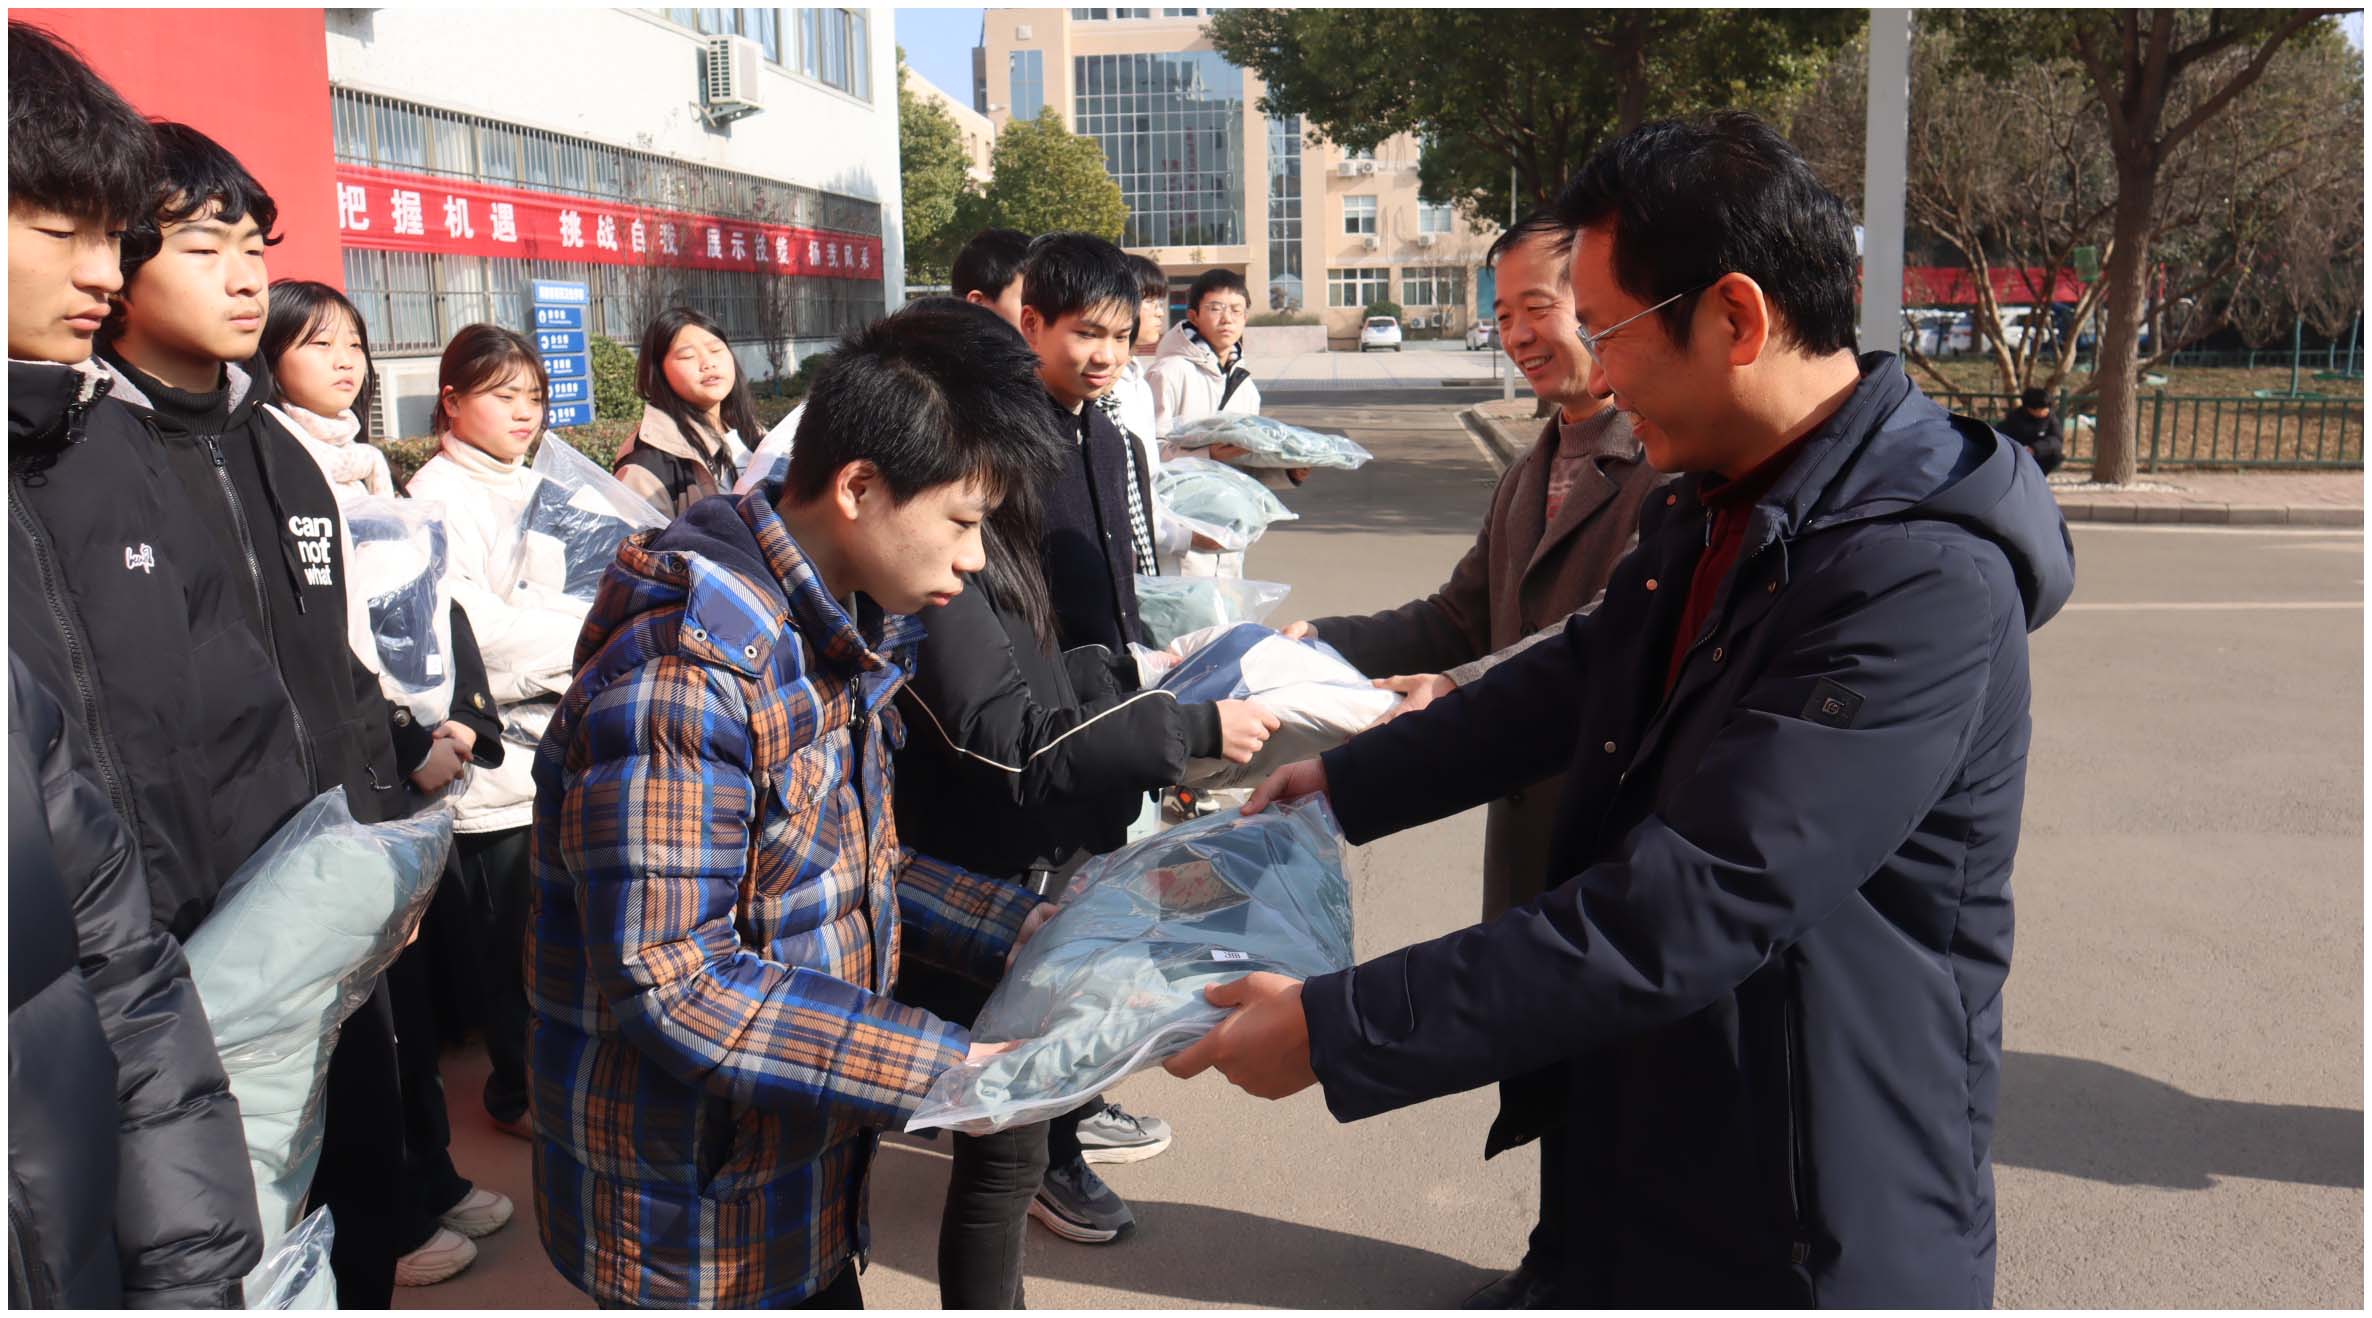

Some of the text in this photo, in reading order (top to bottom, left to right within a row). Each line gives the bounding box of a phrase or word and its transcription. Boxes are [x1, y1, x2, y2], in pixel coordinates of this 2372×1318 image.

[337, 182, 518, 243] 把握机遇
[559, 209, 679, 256] 挑战自我
[289, 515, 333, 537] can
[297, 537, 331, 564] not
